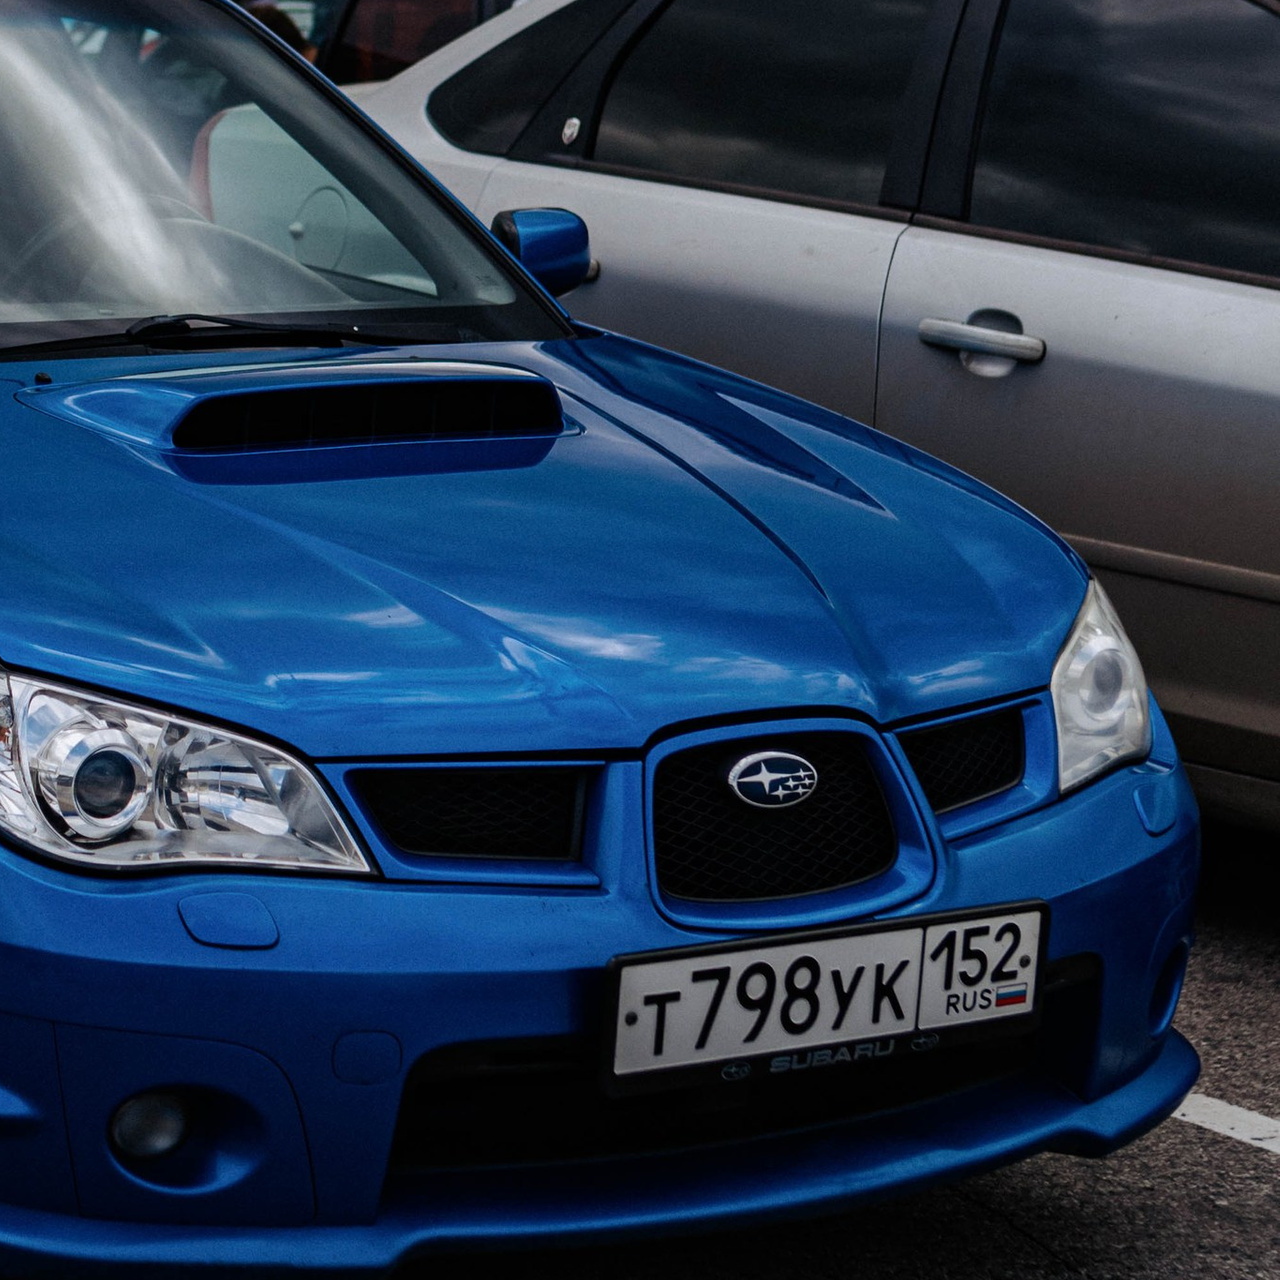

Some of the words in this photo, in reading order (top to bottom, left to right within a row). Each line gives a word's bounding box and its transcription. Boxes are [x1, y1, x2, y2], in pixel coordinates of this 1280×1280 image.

[930, 922, 1022, 990] 152
[945, 987, 992, 1016] RUS
[769, 1038, 896, 1074] SUBARU
